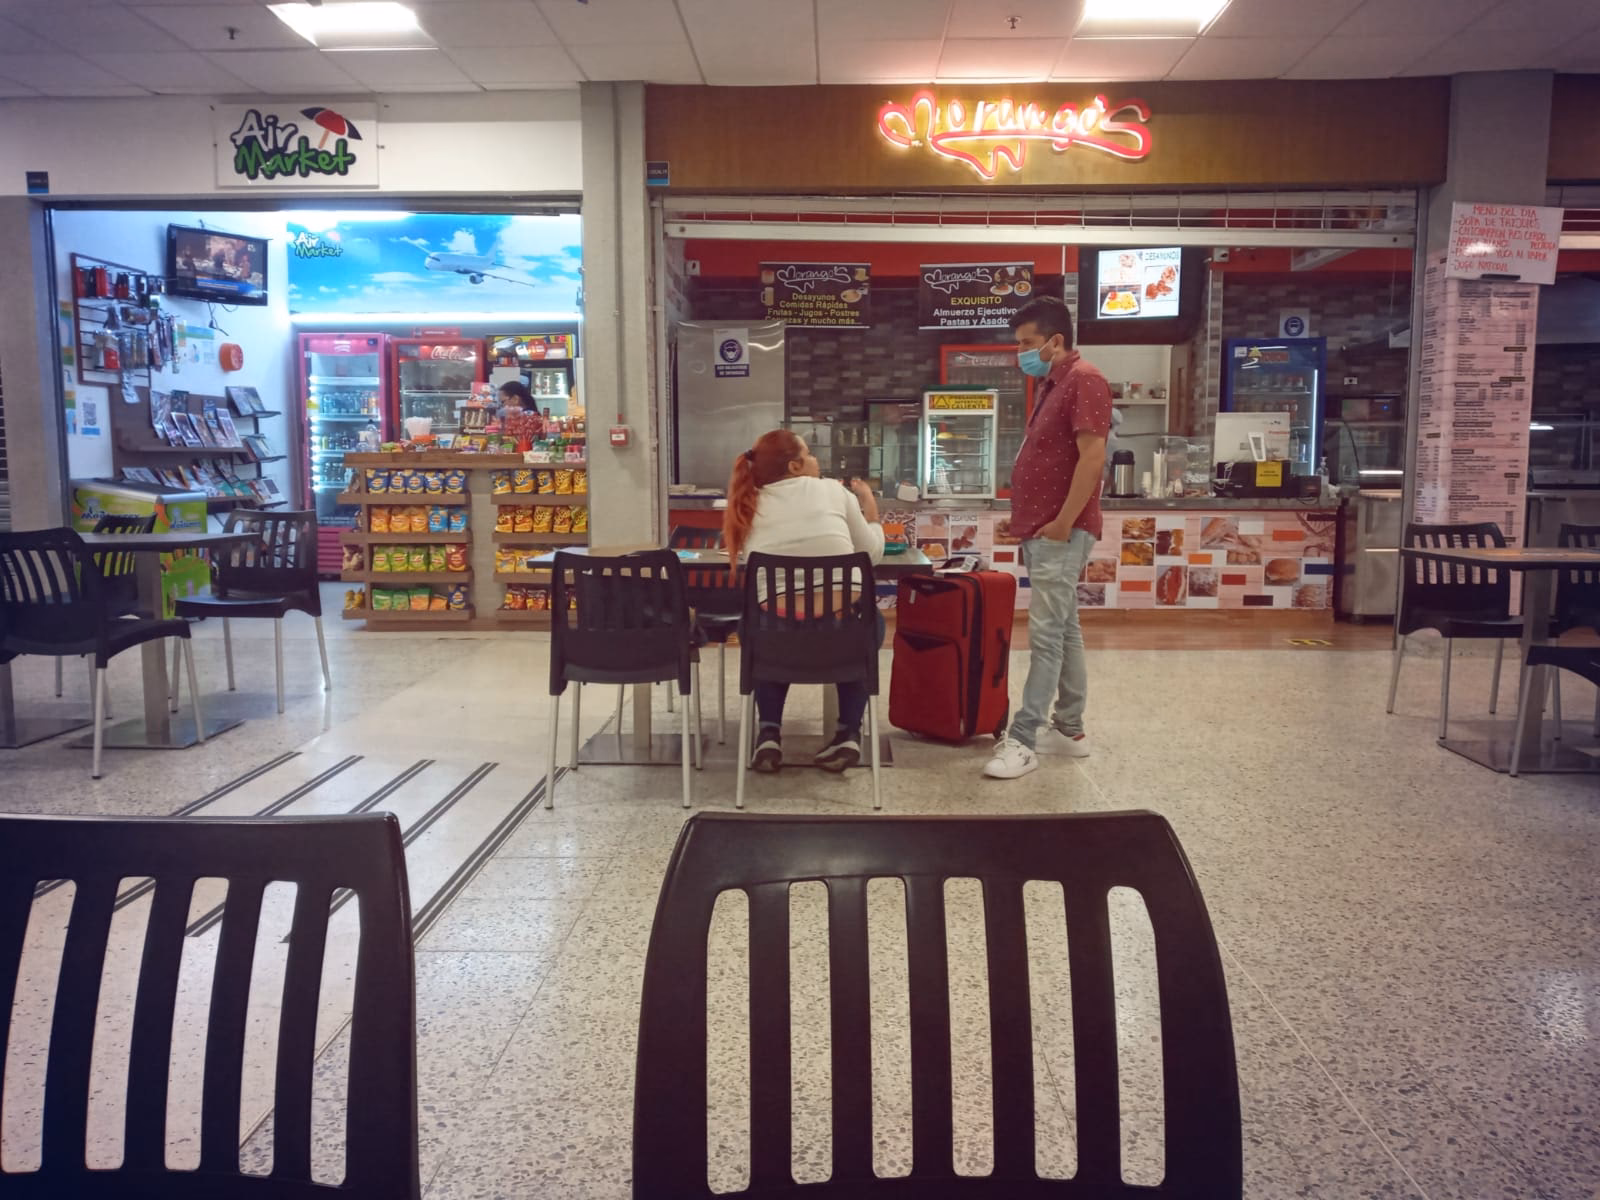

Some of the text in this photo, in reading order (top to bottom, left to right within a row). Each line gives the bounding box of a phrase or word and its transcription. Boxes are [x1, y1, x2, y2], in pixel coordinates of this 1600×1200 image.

[230, 109, 298, 151] Air
[234, 135, 356, 179] Market
[293, 230, 320, 248] Air
[295, 241, 344, 259] Market
[792, 293, 836, 302] Desayunos
[951, 296, 1002, 305] EXQUISITO
[780, 301, 813, 309] Comidas
[767, 308, 792, 316] Frutas
[799, 309, 822, 317] Jugos
[830, 309, 859, 317] Postres
[933, 307, 1018, 317] Almuerzo Ejecutivo
[811, 316, 836, 324] mucho
[940, 318, 970, 326] Pastas
[980, 316, 1010, 325] Asado
